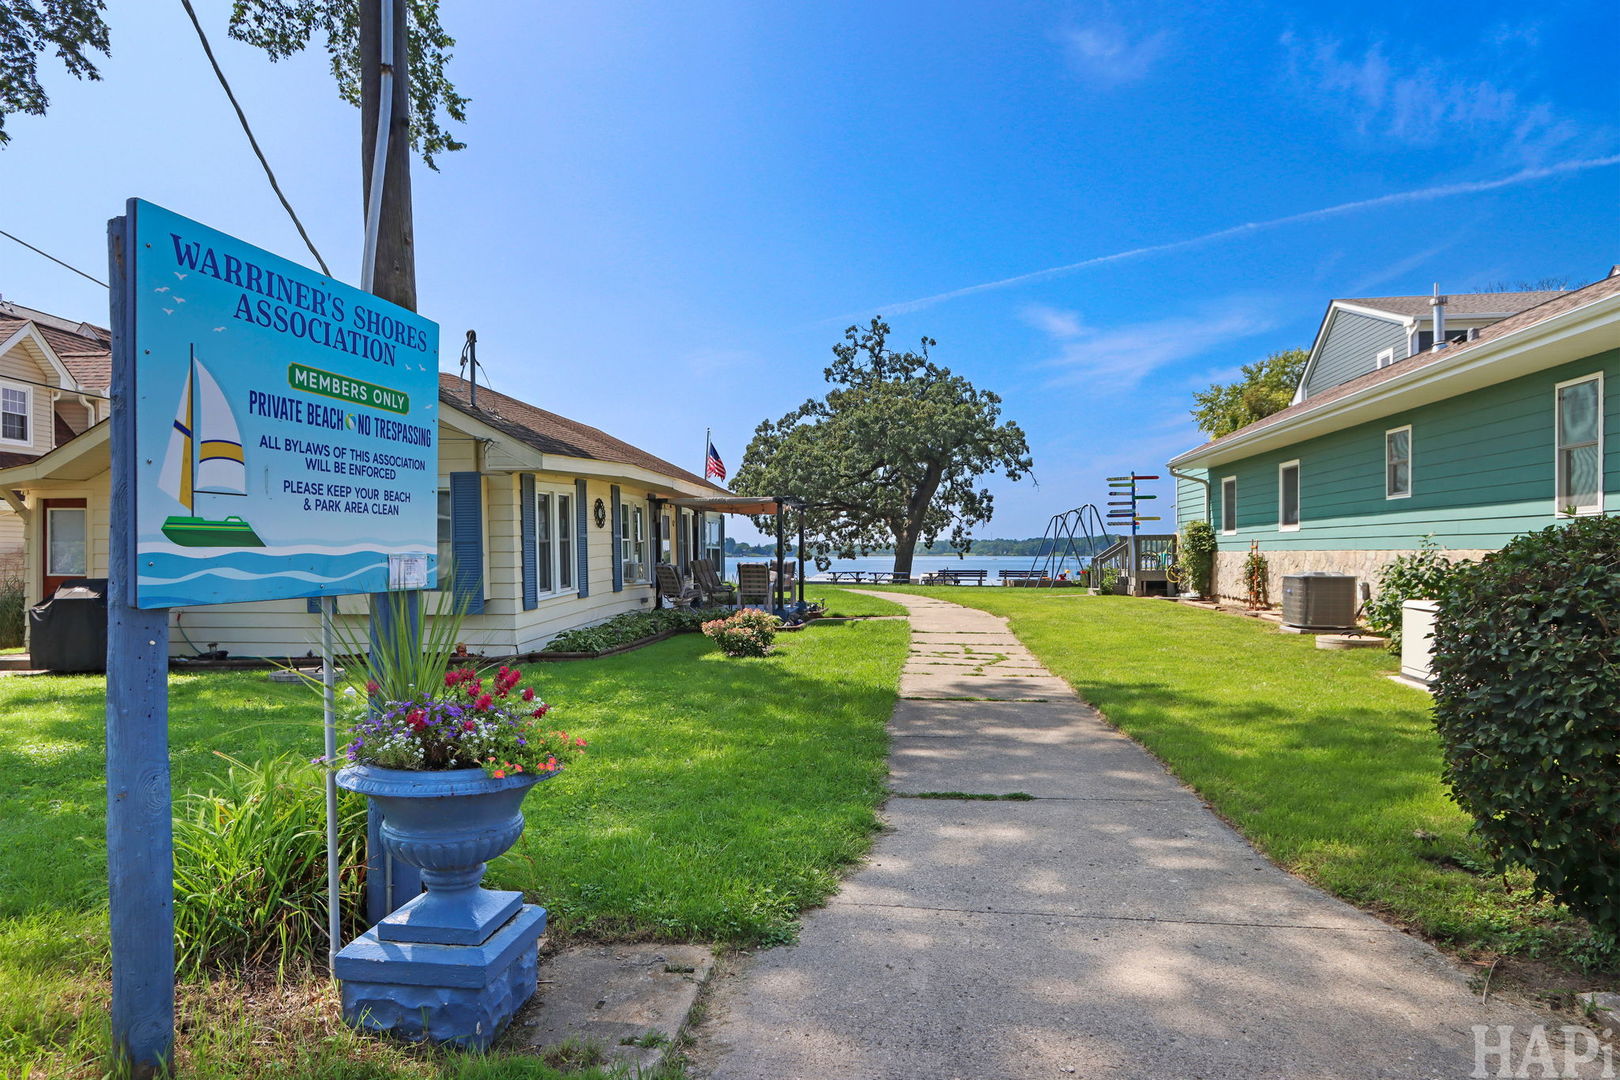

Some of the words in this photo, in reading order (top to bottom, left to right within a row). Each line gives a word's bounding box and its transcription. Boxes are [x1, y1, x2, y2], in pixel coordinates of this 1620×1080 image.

[170, 232, 345, 322] WARRINER'S
[353, 305, 427, 352] SHORES
[233, 293, 396, 366] ASSOCIATION
[295, 368, 367, 400] MEMBERS
[373, 389, 405, 410] ONLY
[249, 390, 303, 423] PRIVATE
[307, 402, 344, 431] BEACH
[357, 413, 371, 436] NO
[374, 417, 431, 448] TRESPASSING
[259, 435, 281, 450] ALL
[284, 438, 331, 457] BYLAWS
[333, 446, 347, 459] OF
[350, 448, 370, 463] THIS
[372, 452, 426, 471] ASSOCIATION
[305, 457, 331, 473] WILL
[334, 461, 346, 474] BE
[349, 463, 397, 480] ENFORCED
[283, 479, 324, 496] PLEASE
[326, 484, 352, 498] KEEP
[354, 486, 380, 500] YOUR
[383, 490, 411, 503] BEACH
[303, 497, 312, 511] &
[315, 498, 341, 513] PARK
[344, 501, 369, 514] AREA
[371, 503, 399, 516] CLEAN
